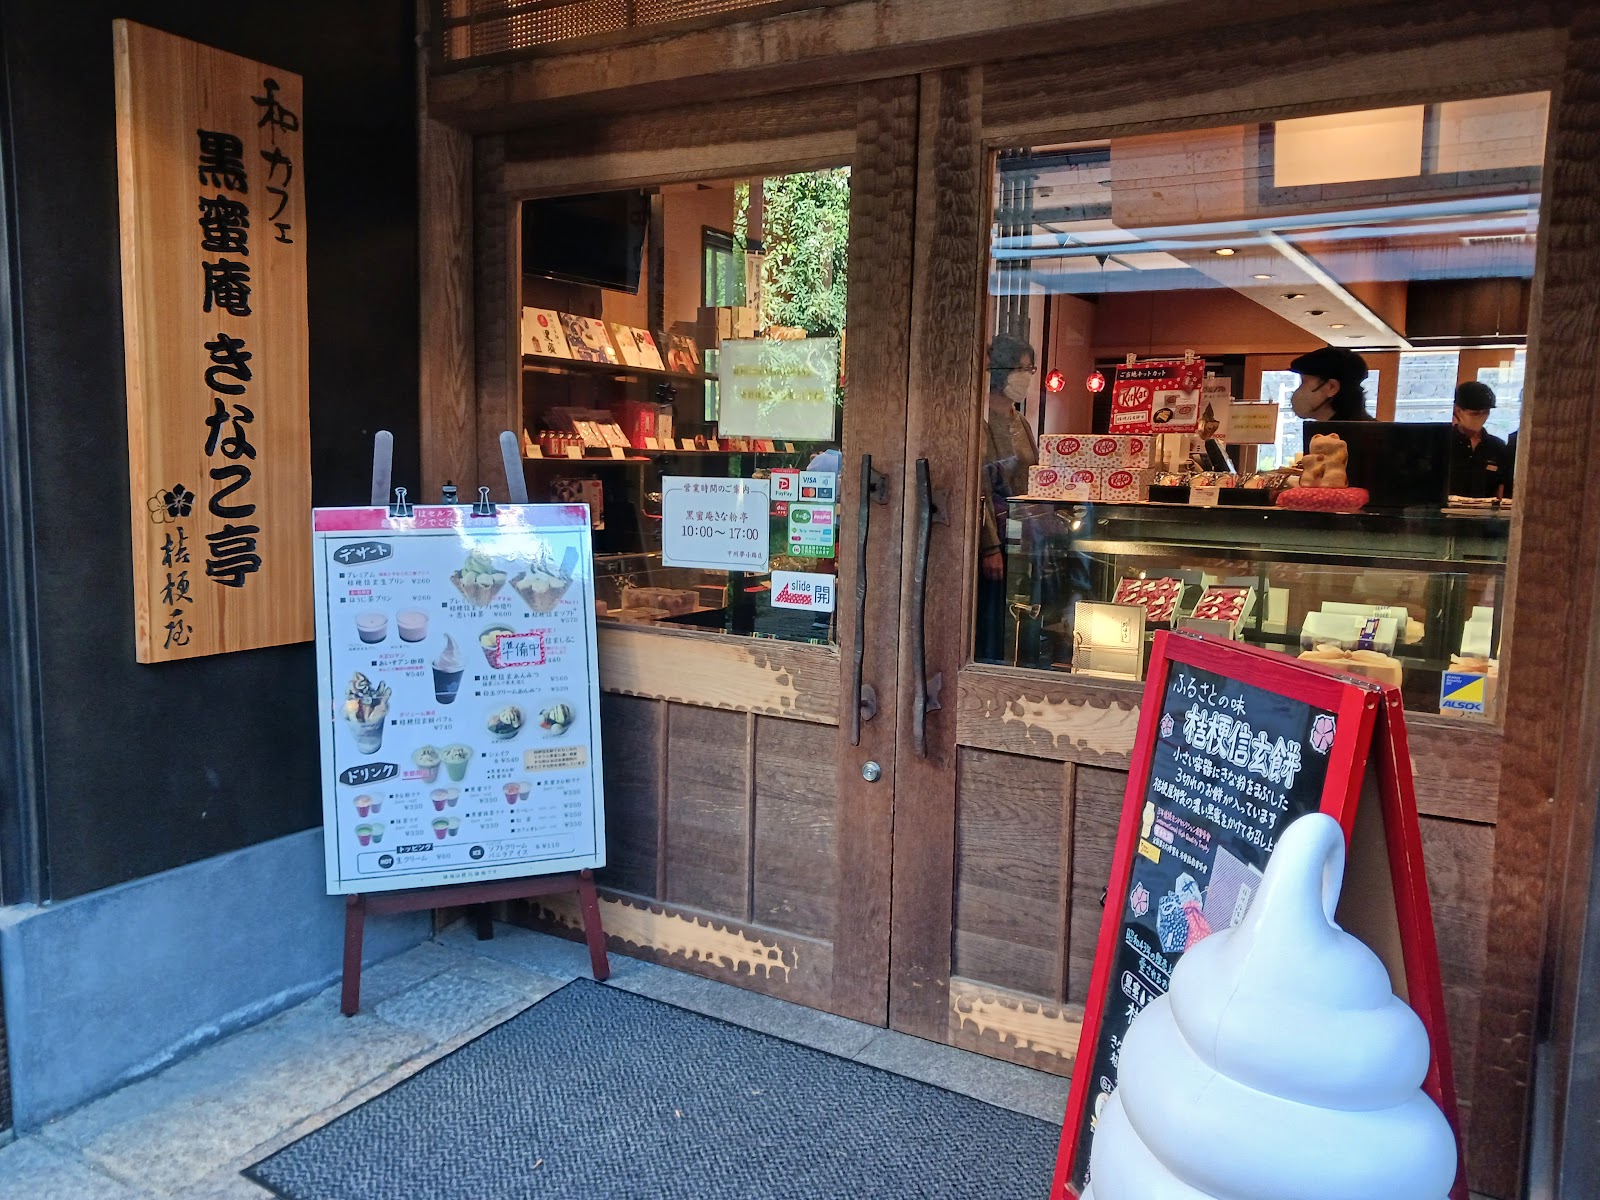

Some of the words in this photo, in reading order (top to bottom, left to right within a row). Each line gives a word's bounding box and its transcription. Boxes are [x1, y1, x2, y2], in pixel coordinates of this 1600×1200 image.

[250, 78, 299, 246] 和カフェ
[1119, 369, 1167, 379] ご当地キットカット
[683, 483, 751, 495] 営業時間のご案内
[803, 476, 817, 484] VISA
[338, 545, 389, 562] デザート
[159, 526, 195, 650] 桔梗屋
[791, 580, 811, 593] slide
[814, 585, 830, 604] 開
[502, 641, 540, 660] 準備中
[1172, 673, 1247, 716] ふるさとの味
[1442, 701, 1481, 711] ALSOK
[489, 750, 510, 758] シェイク
[1183, 702, 1302, 790] 桔梗信玄餅
[347, 765, 394, 784] ドリンク
[1172, 746, 1290, 812] 小さい容器にきな粉をまぶした
[1174, 766, 1278, 830] 3切れのお餅が入っています
[399, 843, 432, 853] トッピング
